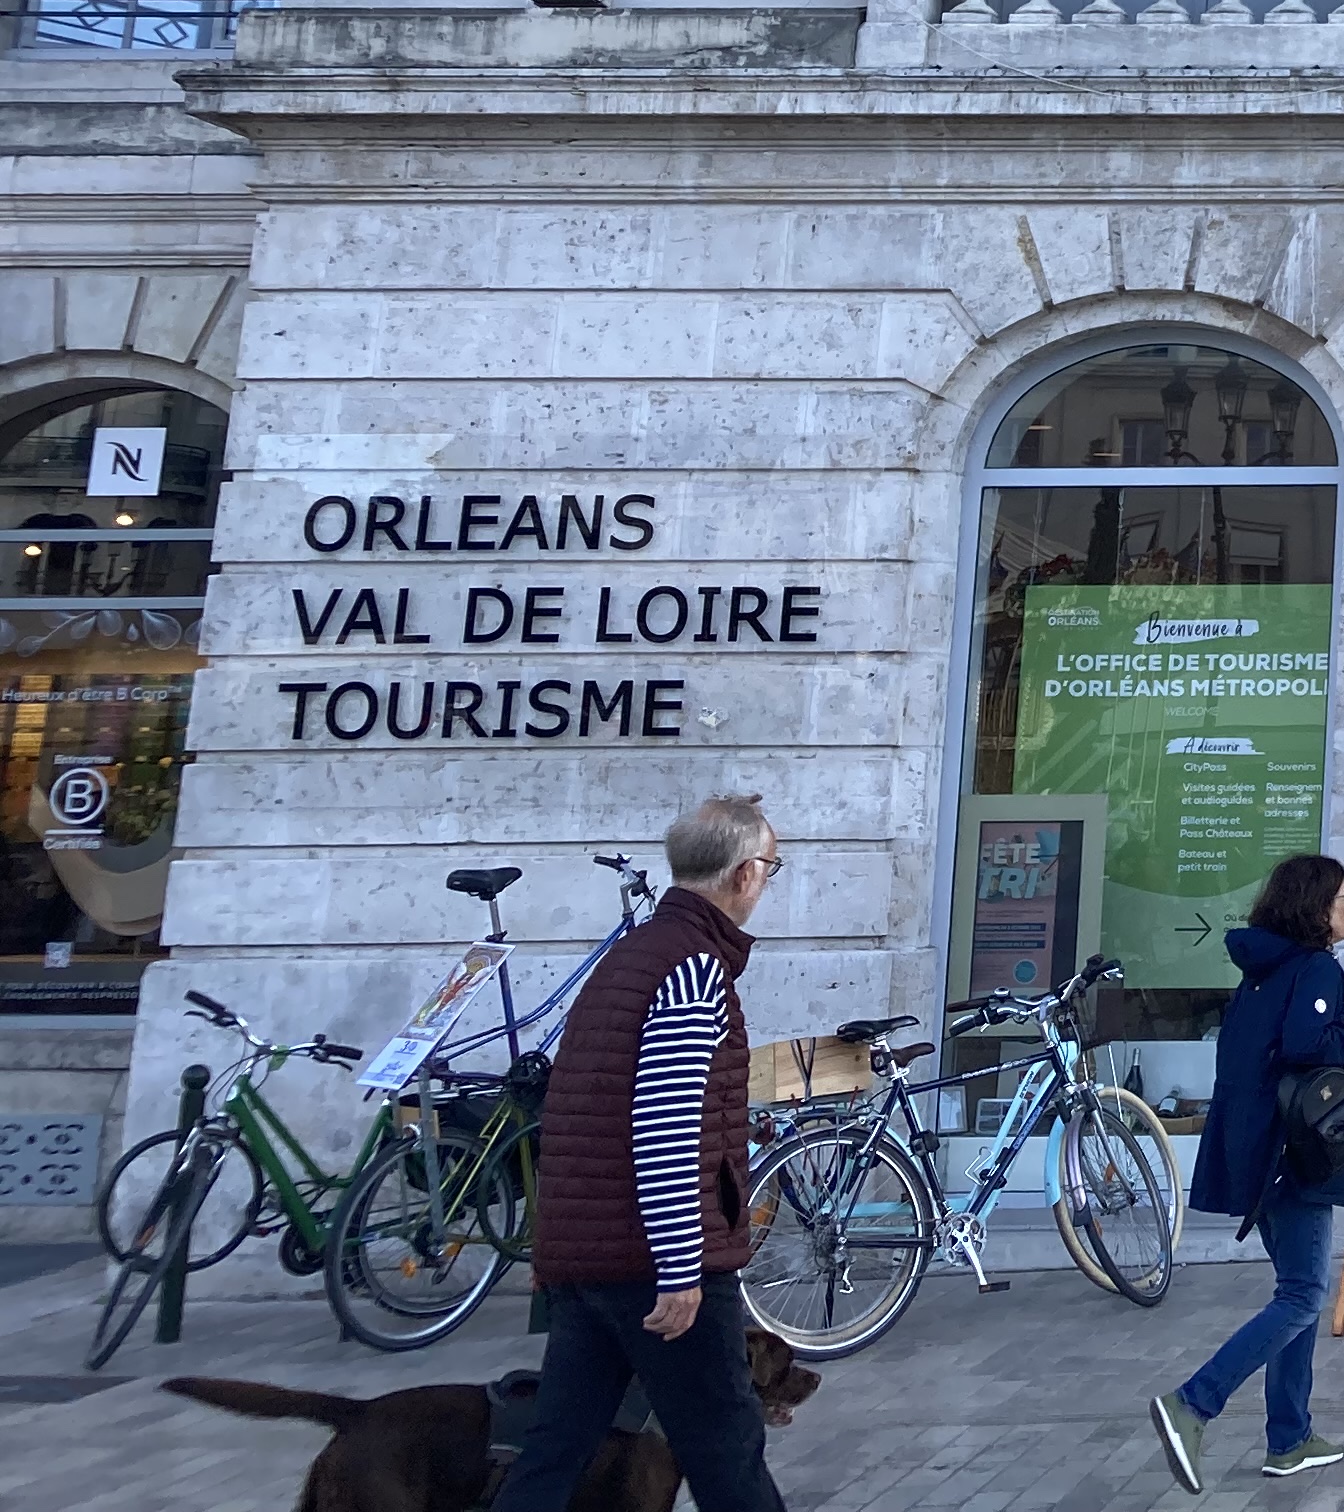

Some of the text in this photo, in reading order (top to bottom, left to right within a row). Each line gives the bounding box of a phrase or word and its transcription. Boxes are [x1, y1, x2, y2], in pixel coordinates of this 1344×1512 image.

[304, 494, 656, 552] ORLEANS
[291, 586, 822, 645] VAL DE LOIRE
[1048, 615, 1100, 626] ORLÉANS
[1146, 610, 1229, 643] Bienvenue
[1057, 653, 1328, 672] L'OFFICE DE TOURISME
[1045, 674, 1185, 697] D'ORLÉANS
[2, 690, 65, 701] Heureux
[279, 679, 686, 740] TOURISME
[1183, 762, 1227, 773] CityPass
[1267, 762, 1316, 772] Souvenirs
[1183, 782, 1256, 795] Visites guidées
[1181, 795, 1254, 807] et audioguides
[1265, 794, 1313, 805] et bonnes
[1264, 808, 1310, 818] adresses
[1180, 815, 1241, 826] Billetterie et
[1180, 828, 1253, 838] Pass Châteaux
[1178, 849, 1227, 859] Bateau et
[1178, 862, 1227, 873] petit train
[978, 867, 1041, 900] TRI
